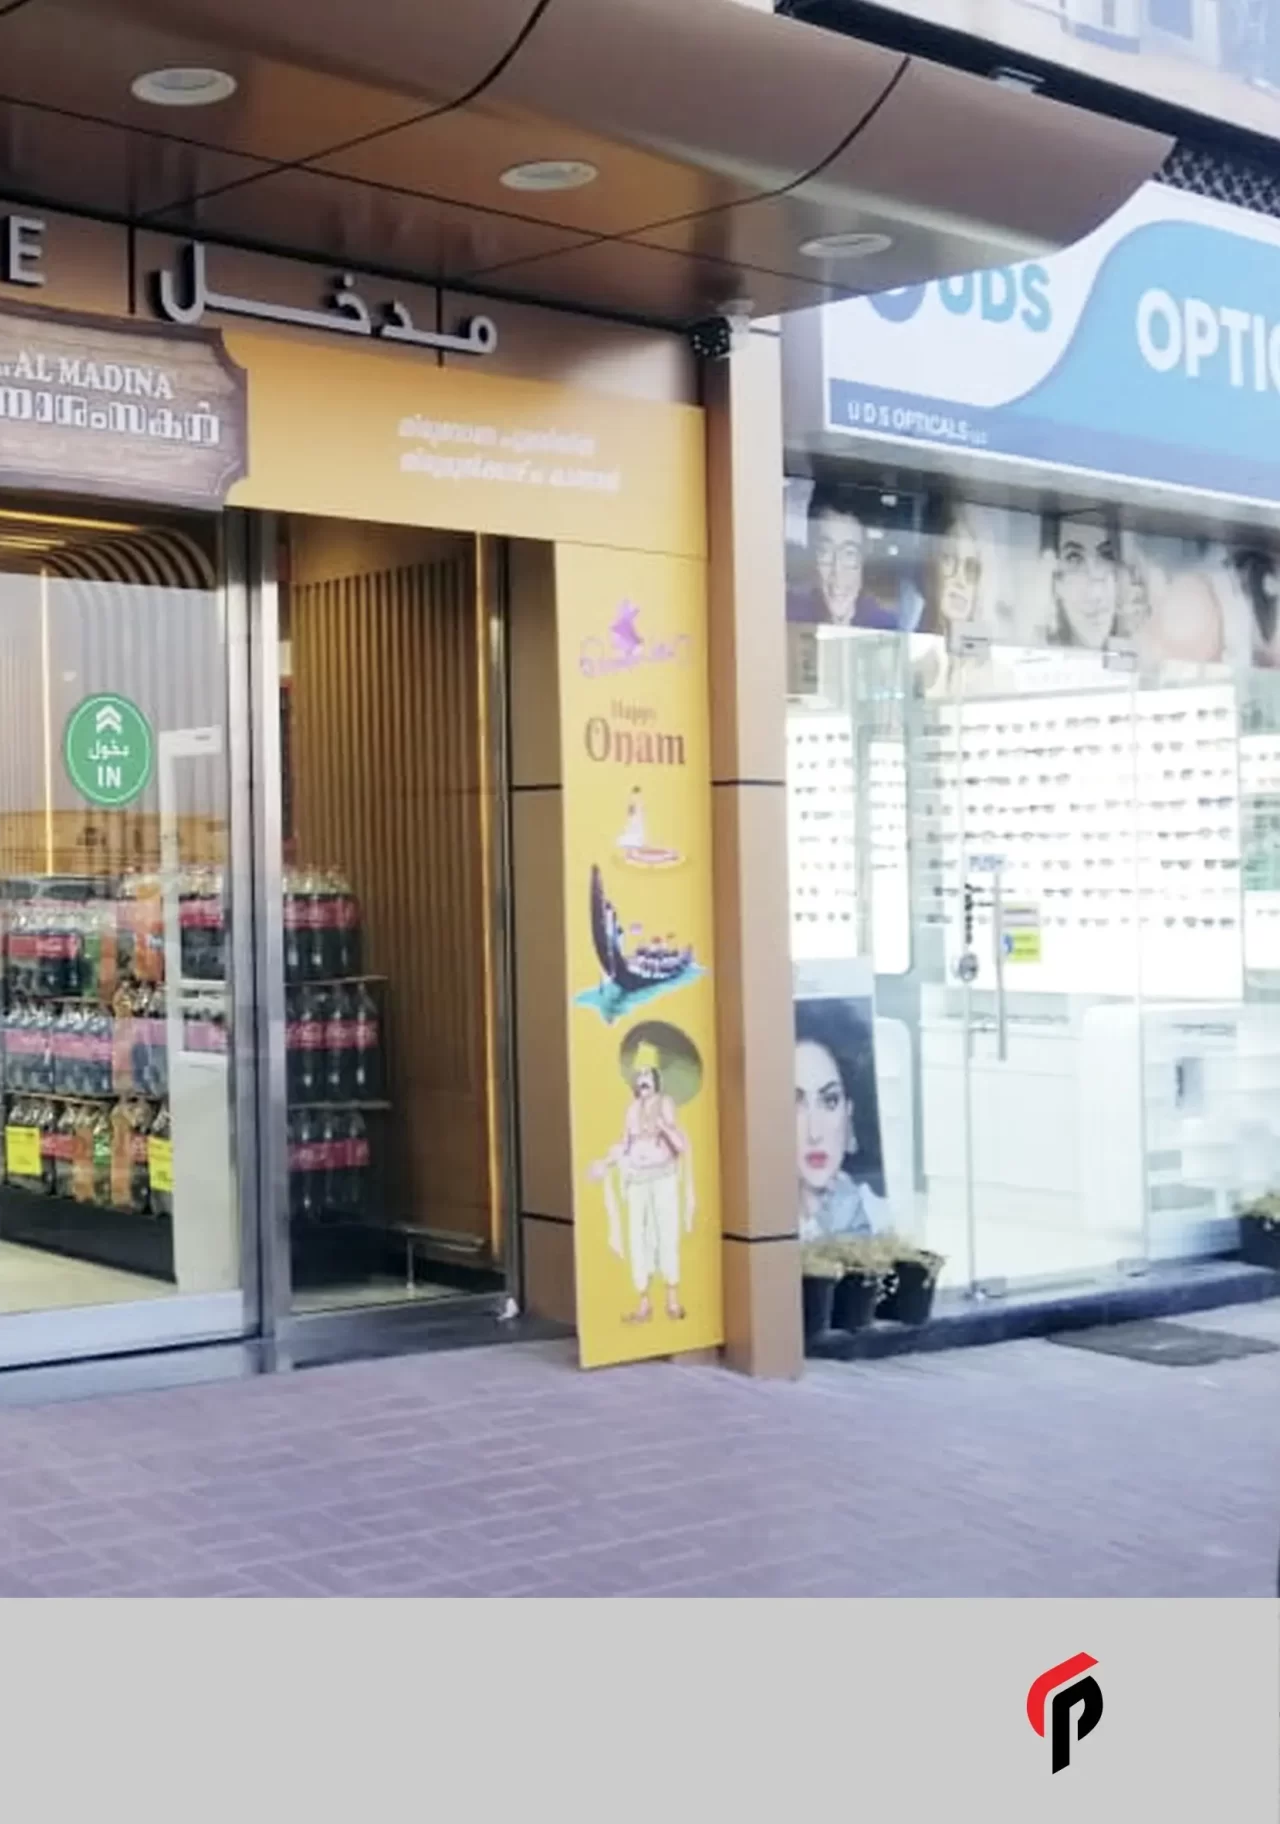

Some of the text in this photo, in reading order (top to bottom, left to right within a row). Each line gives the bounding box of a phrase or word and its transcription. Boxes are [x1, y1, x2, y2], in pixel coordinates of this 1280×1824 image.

[160, 240, 498, 354] مدخل
[938, 262, 1053, 334] UDS
[13, 350, 54, 383] AL
[58, 355, 175, 401] MADINA
[892, 406, 969, 441] OPTICALS
[584, 716, 686, 766] Onam
[96, 764, 122, 789] IN
